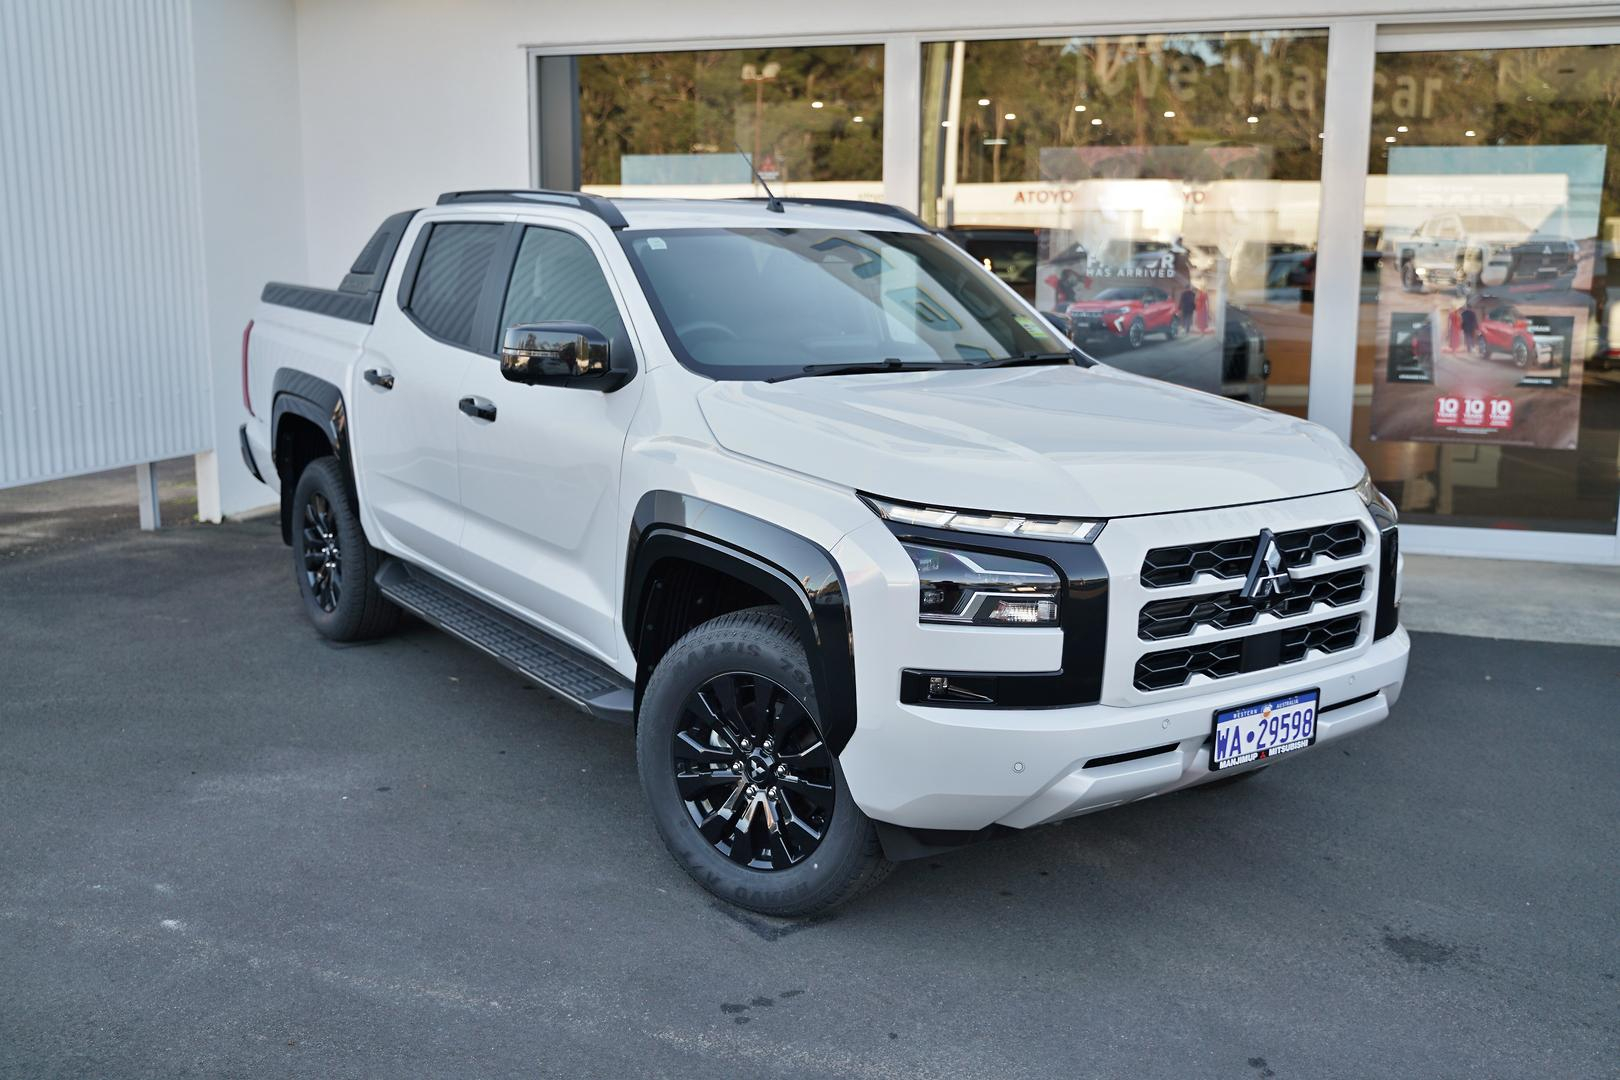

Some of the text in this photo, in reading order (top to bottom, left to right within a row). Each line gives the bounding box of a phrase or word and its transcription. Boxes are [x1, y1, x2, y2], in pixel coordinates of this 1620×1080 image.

[1224, 45, 1327, 112] tha
[1087, 268, 1176, 279] HAS ARRIVED
[1438, 398, 1512, 416] 10 10 10
[1219, 739, 1309, 769] MANJIMUP MITSUBISHI
